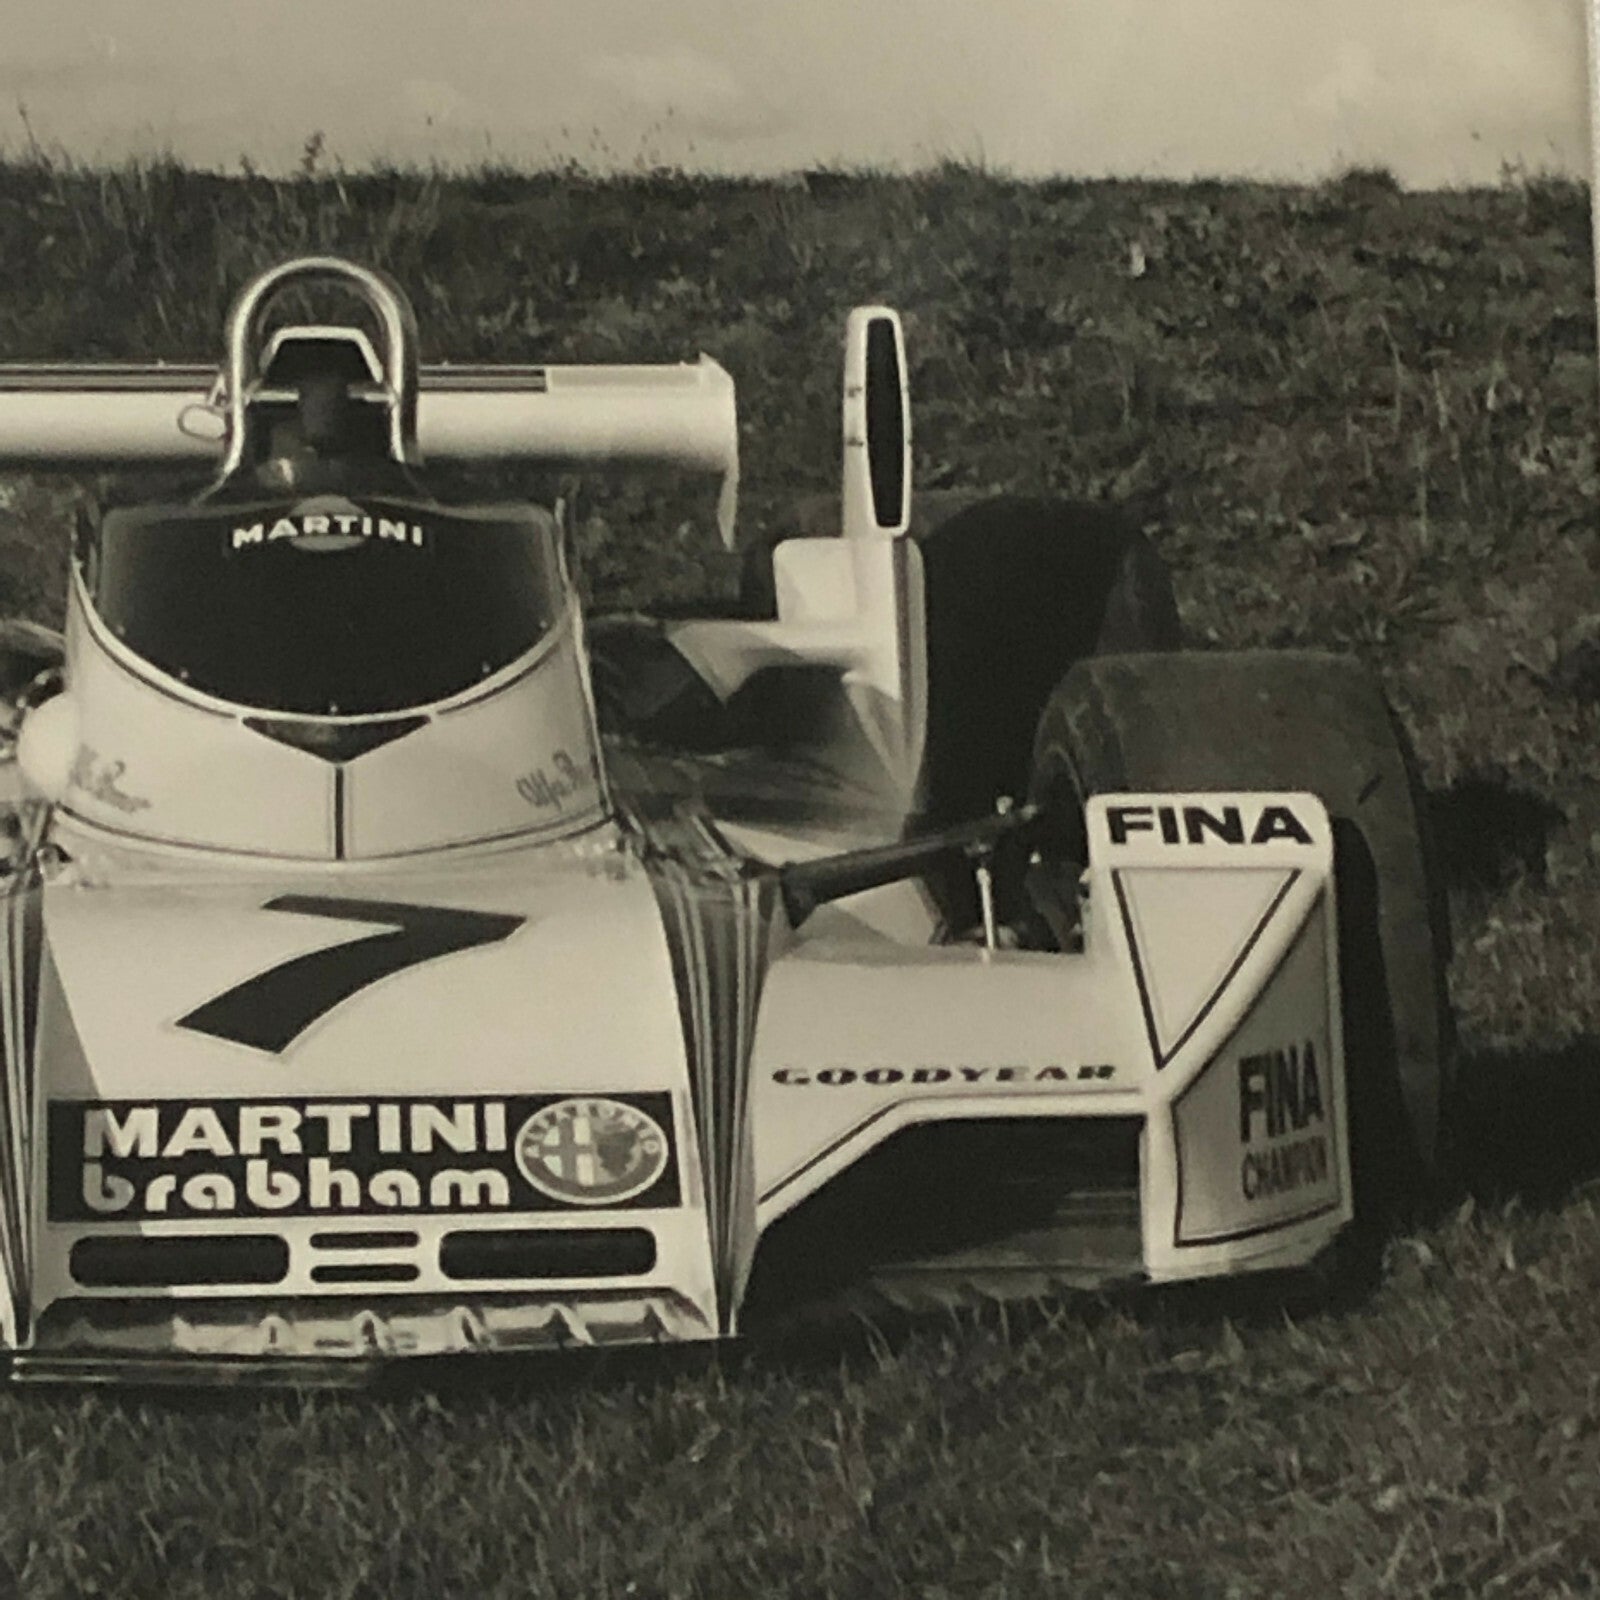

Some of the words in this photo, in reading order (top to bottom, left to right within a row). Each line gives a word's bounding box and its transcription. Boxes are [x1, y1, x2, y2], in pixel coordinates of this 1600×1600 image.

[231, 514, 423, 549] MARTINI
[1106, 806, 1313, 844] FINA
[175, 893, 528, 1055] 7
[771, 1064, 1116, 1085] GOODYEAR
[1239, 1038, 1325, 1145] FINA
[83, 1103, 506, 1158] MARTINI
[82, 1157, 510, 1212] brabham
